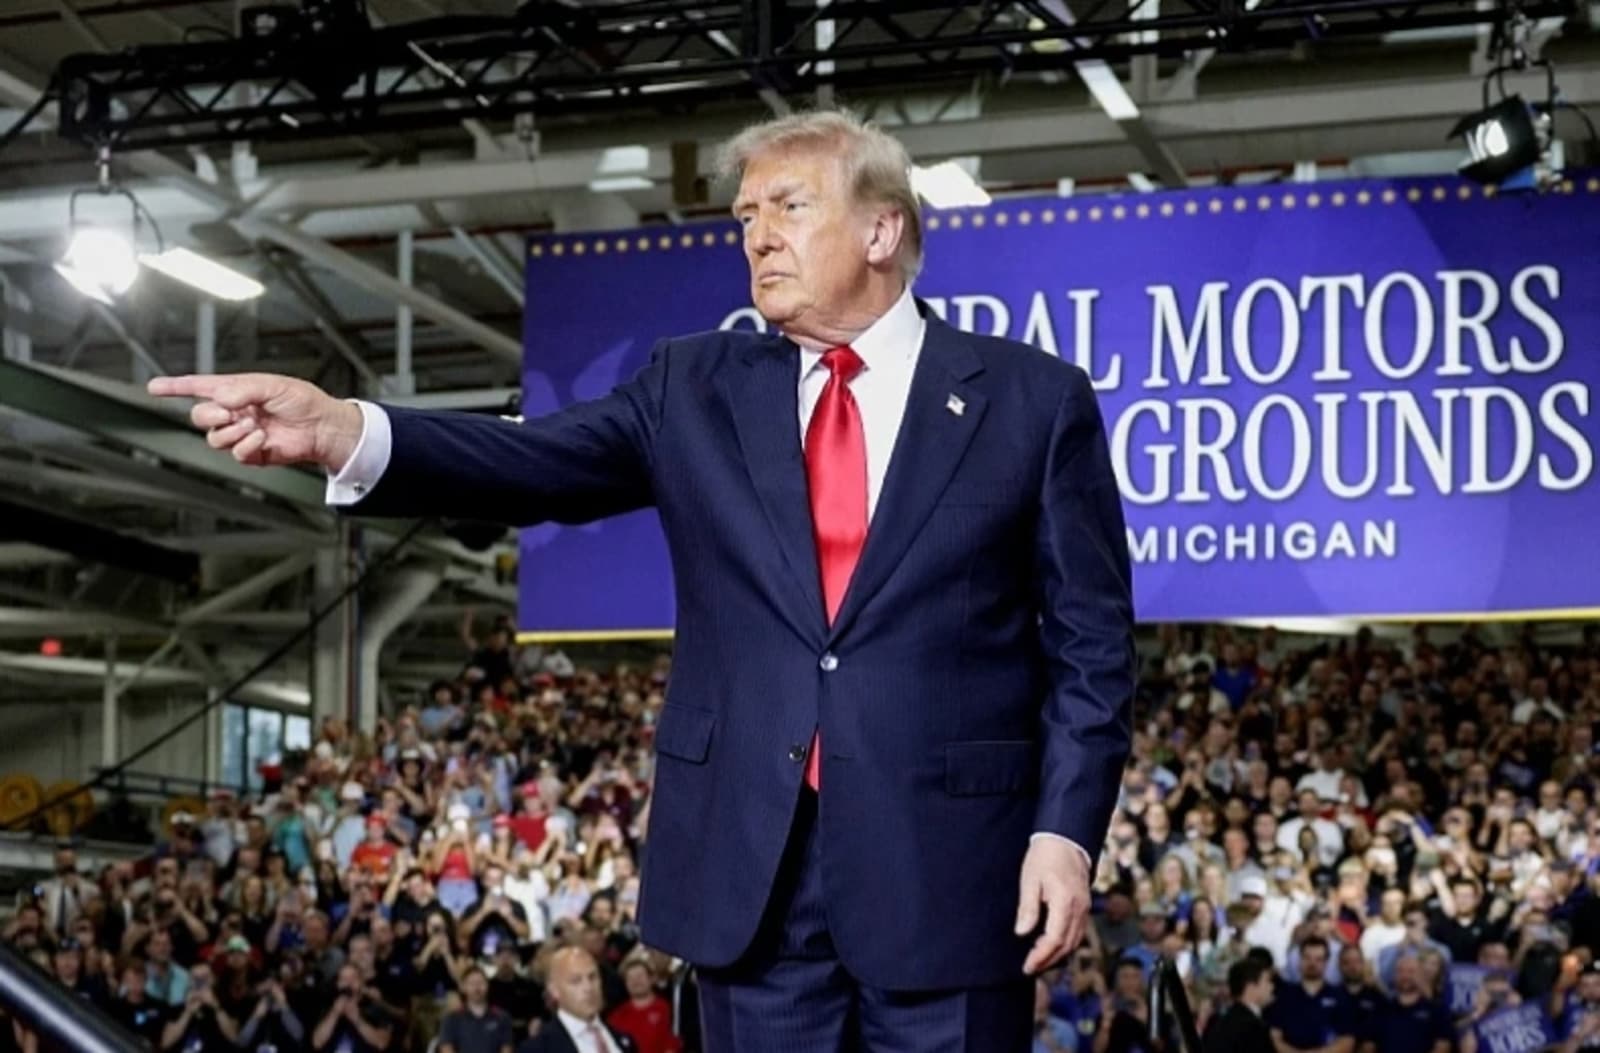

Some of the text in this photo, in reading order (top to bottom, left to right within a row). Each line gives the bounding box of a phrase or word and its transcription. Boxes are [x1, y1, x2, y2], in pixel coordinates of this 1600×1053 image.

[1142, 265, 1564, 388] MOTORS
[1110, 382, 1593, 504] GROUNDS
[1126, 519, 1396, 563] MICHIGAN
